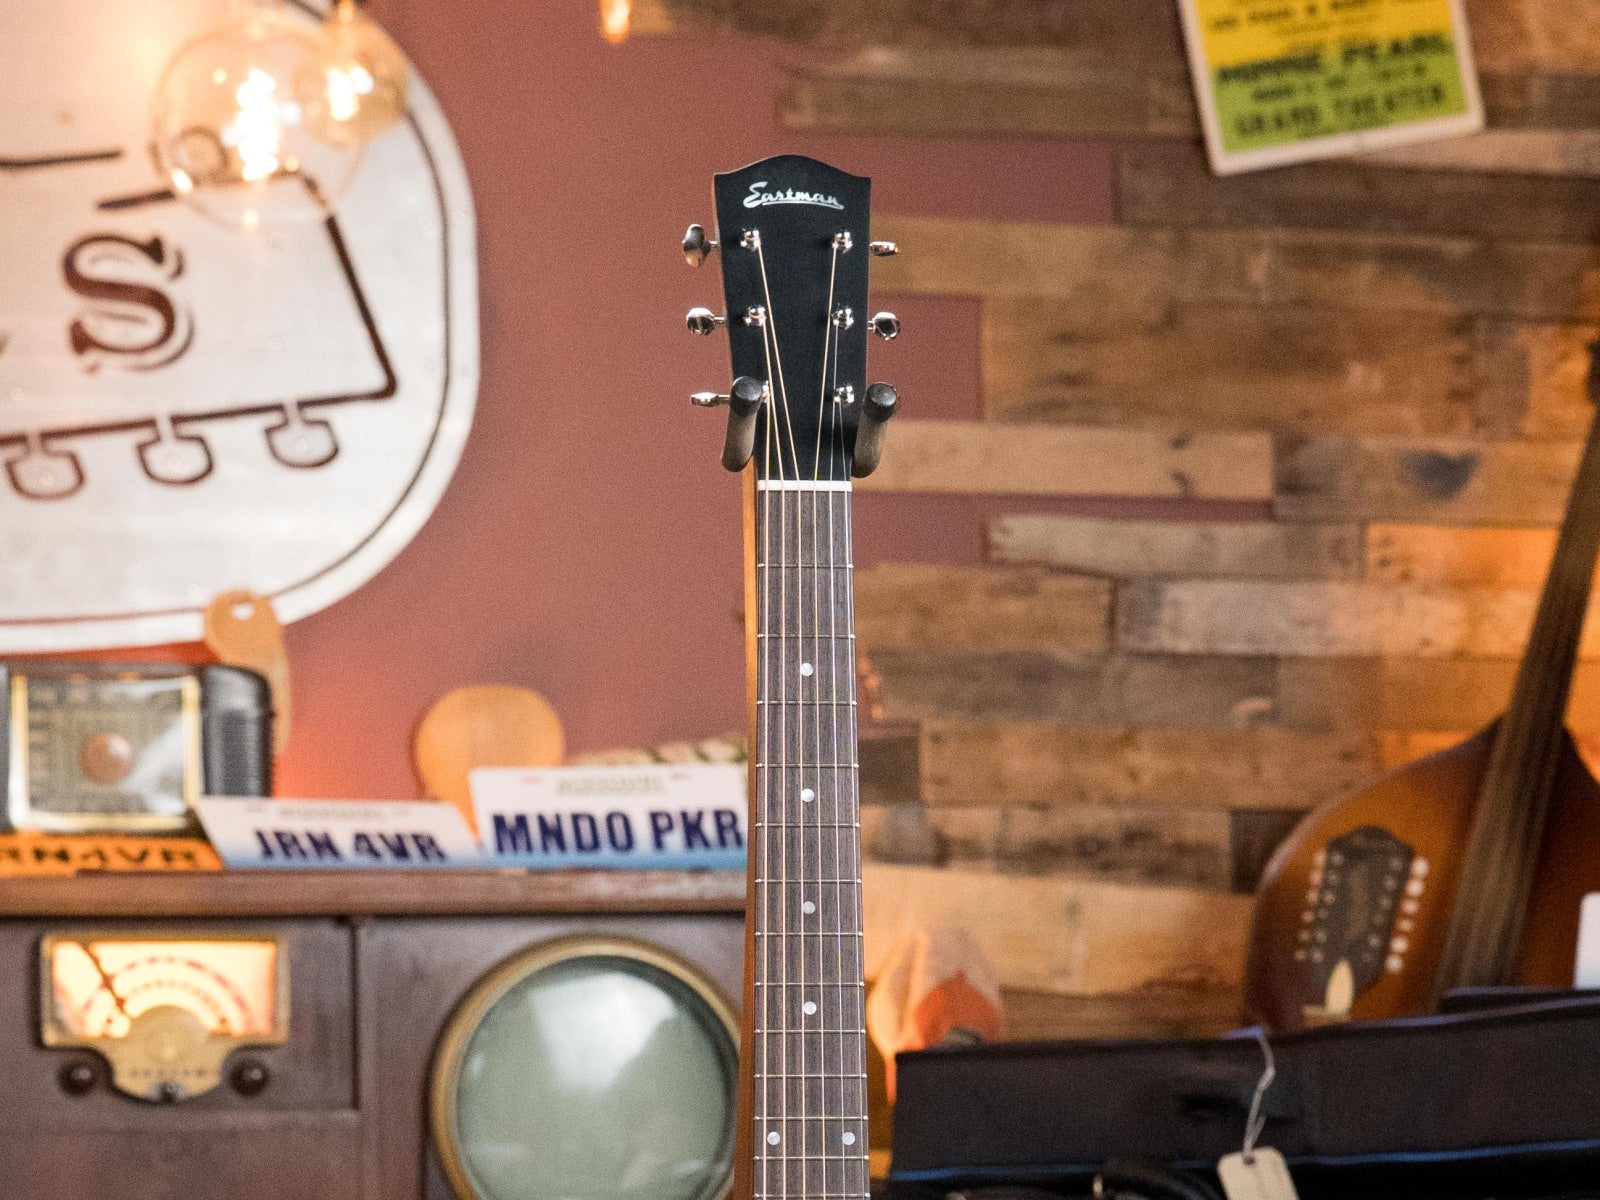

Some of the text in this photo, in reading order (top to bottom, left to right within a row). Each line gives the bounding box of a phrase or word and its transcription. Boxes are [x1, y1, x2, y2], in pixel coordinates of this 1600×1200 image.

[742, 180, 845, 210] Eastman
[493, 808, 745, 855] MNDO PKR
